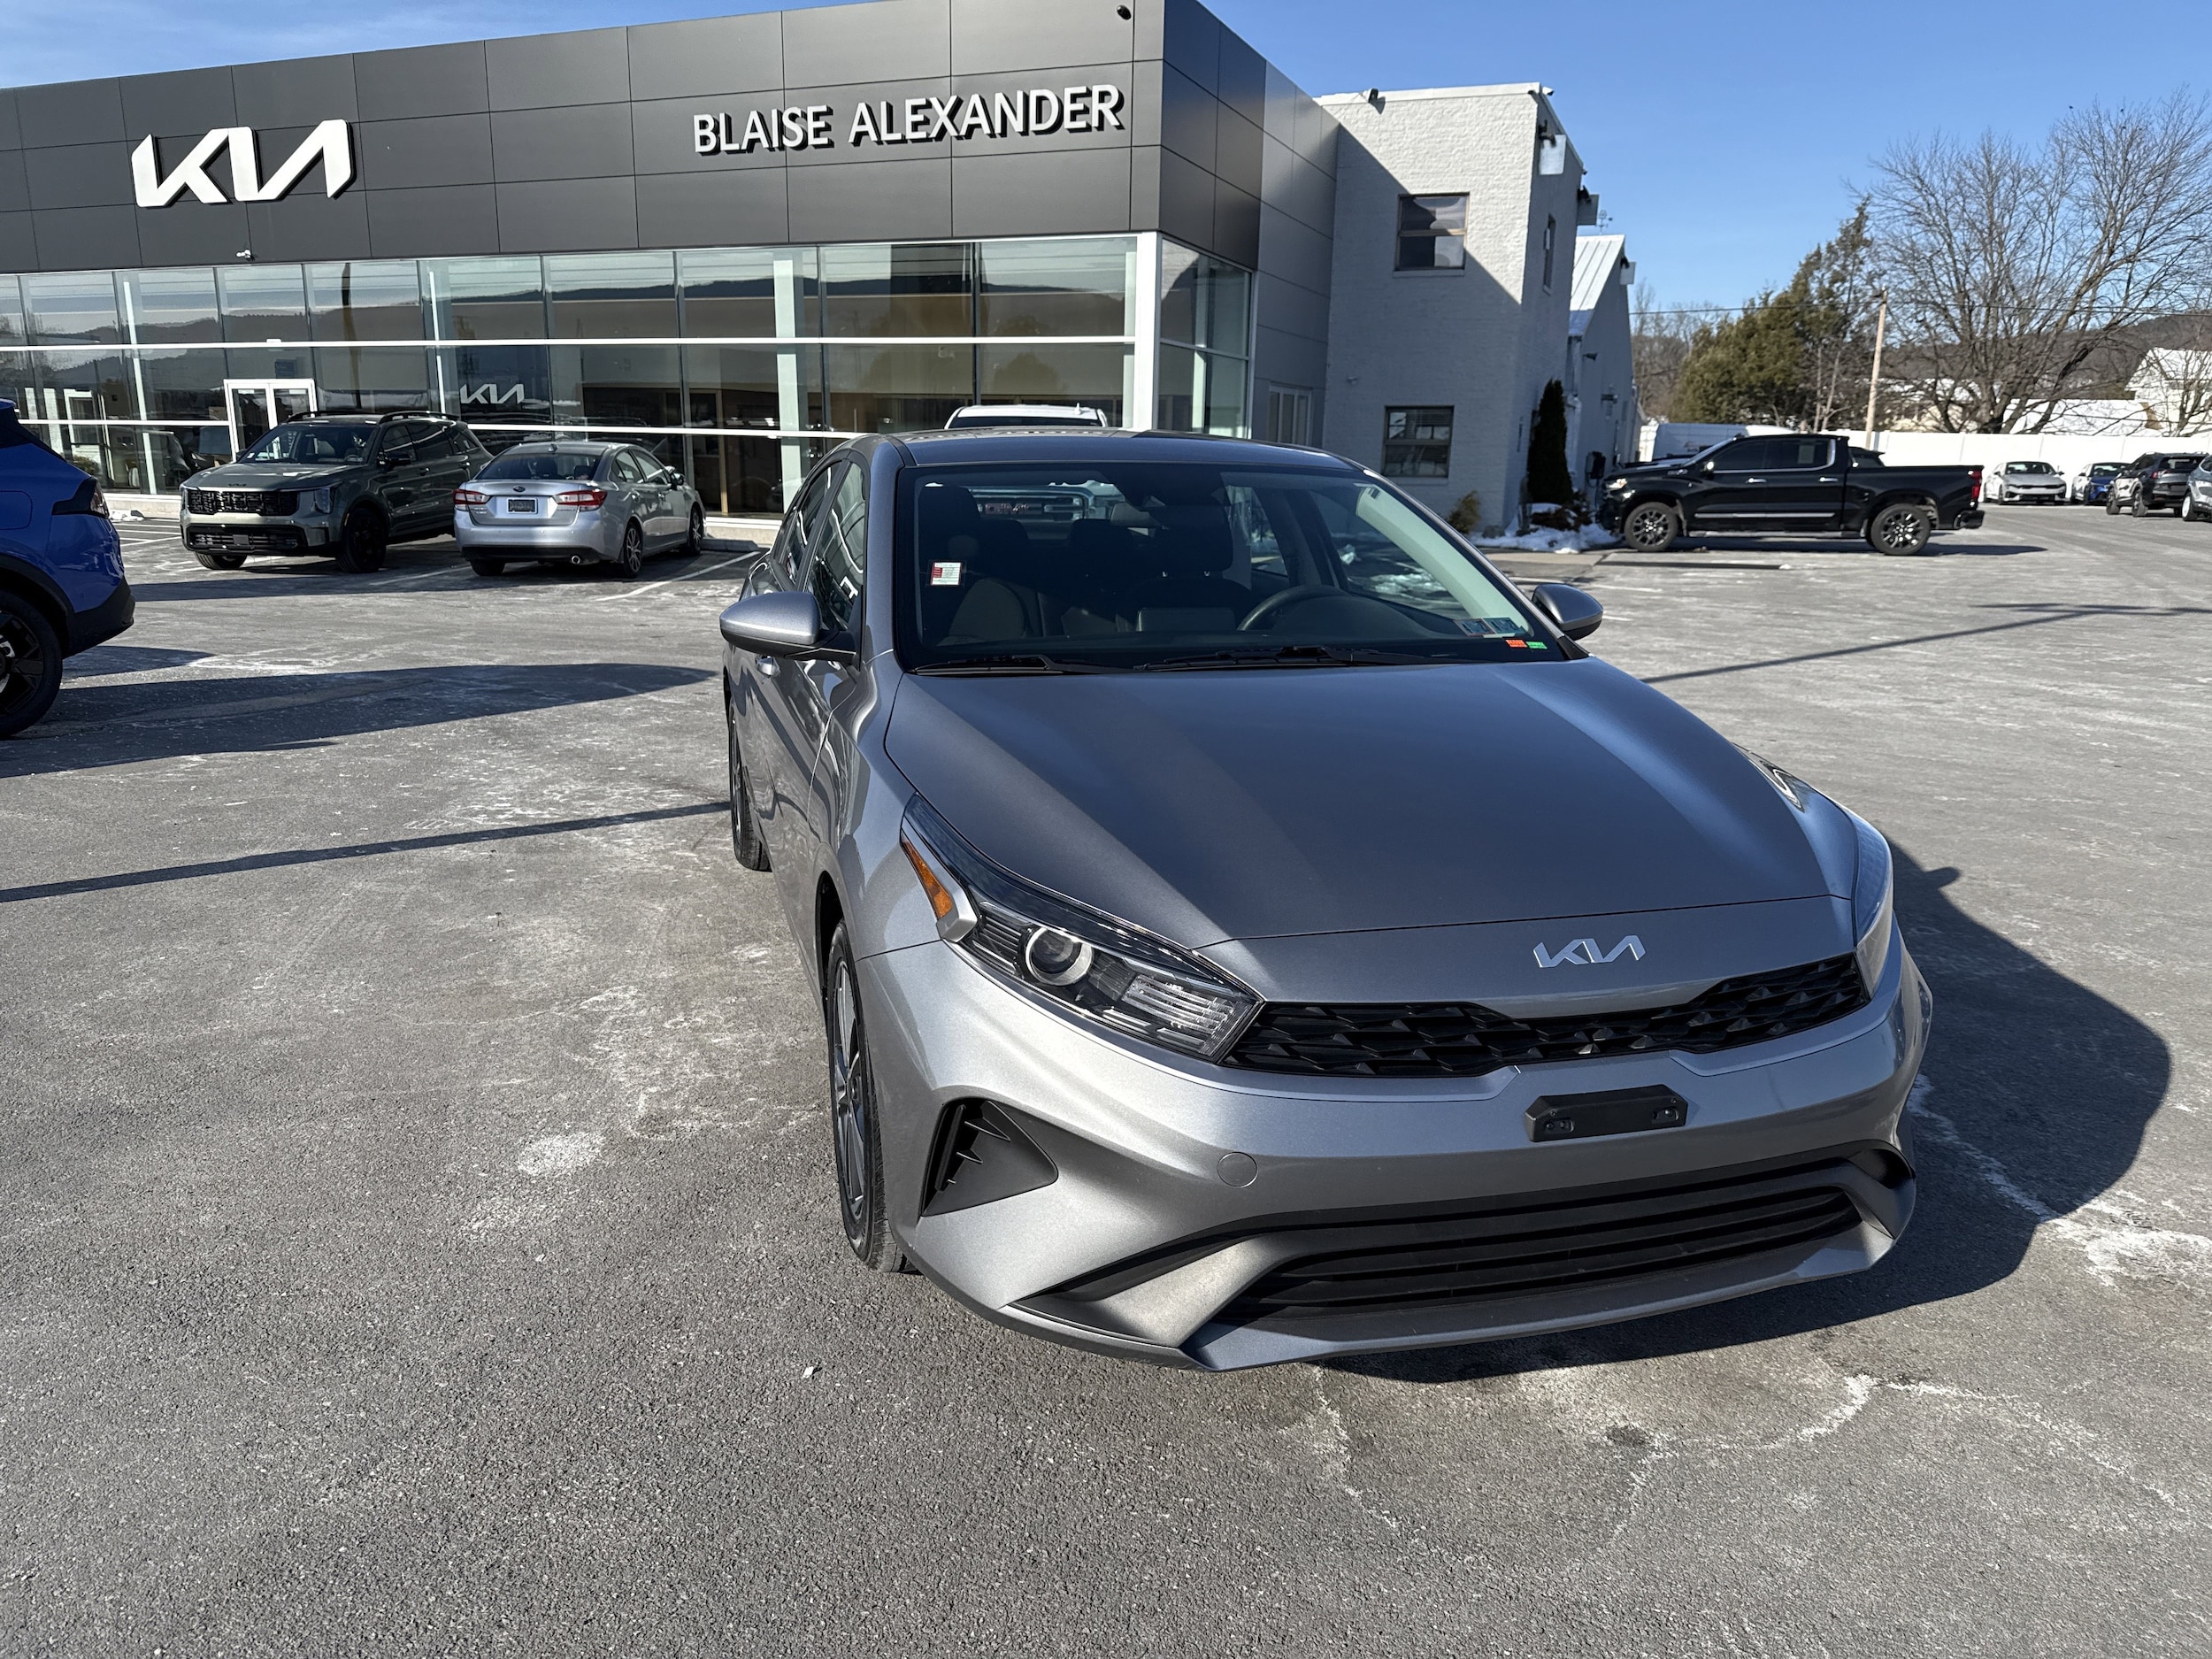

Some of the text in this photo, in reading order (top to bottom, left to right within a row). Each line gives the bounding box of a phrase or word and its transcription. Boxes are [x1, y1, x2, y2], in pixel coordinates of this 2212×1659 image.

[693, 84, 1122, 153] BLAISE ALEXANDER
[131, 119, 352, 208] KIA
[459, 383, 525, 404] KIA
[1533, 934, 1647, 968] KIA
